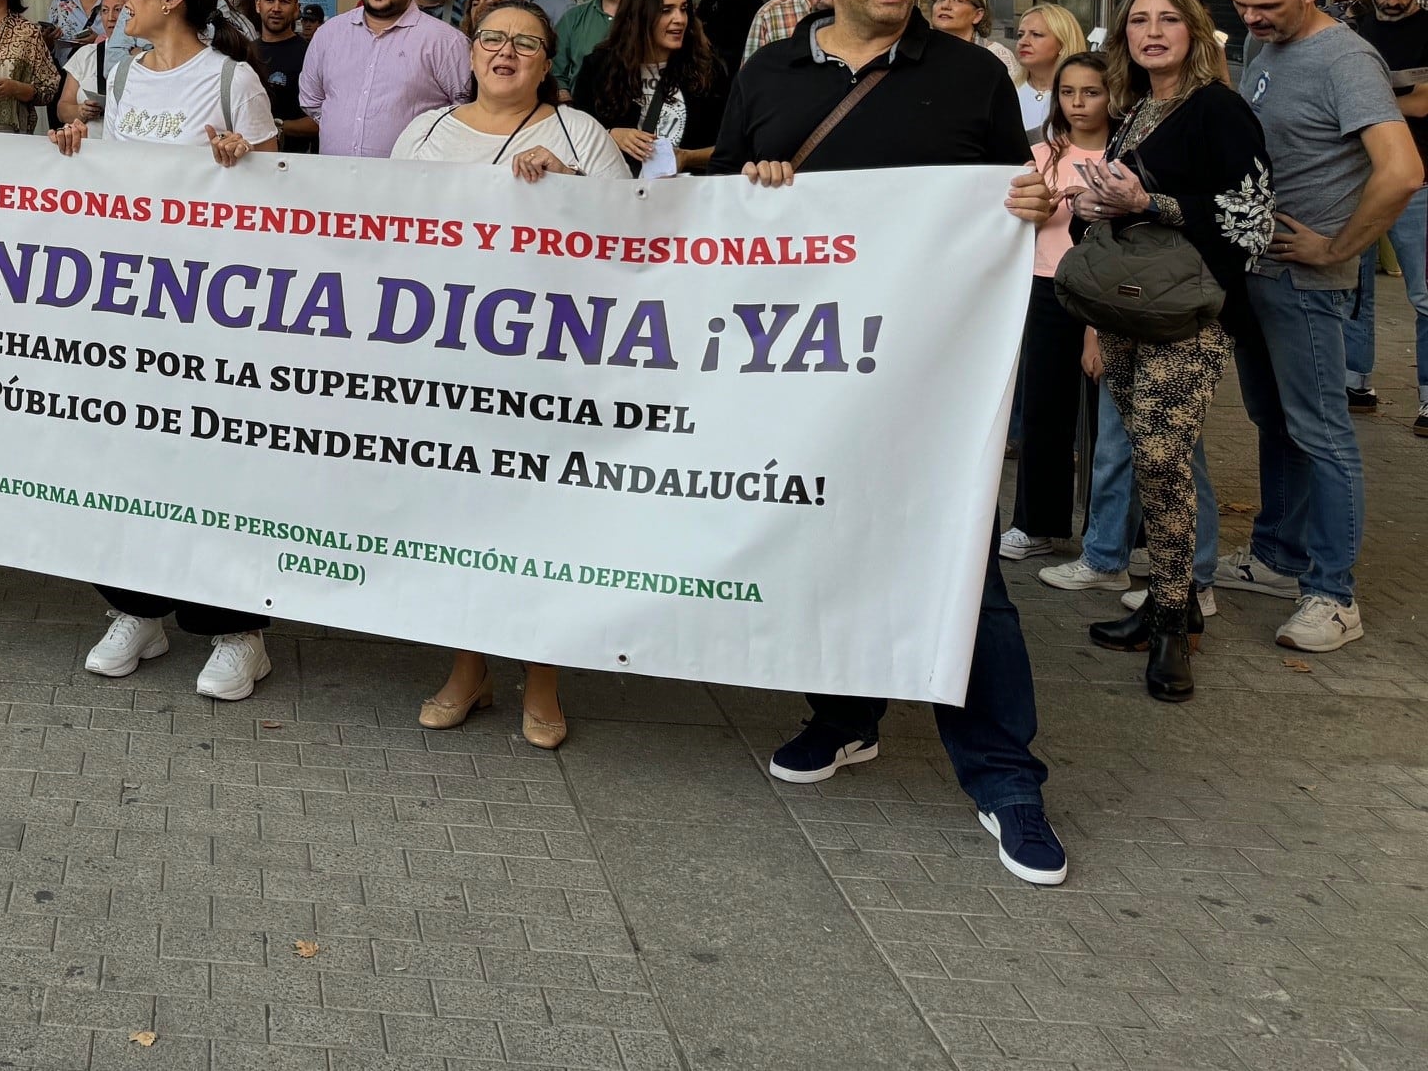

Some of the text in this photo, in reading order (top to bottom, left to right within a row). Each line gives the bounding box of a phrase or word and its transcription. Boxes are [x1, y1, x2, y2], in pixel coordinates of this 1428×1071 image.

[160, 198, 464, 248] DEPENDIENTES
[472, 223, 502, 251] Y
[510, 225, 858, 266] PROFESIONALES
[367, 276, 679, 371] DIGNA
[700, 301, 884, 374] ¡YA!
[135, 347, 207, 383] POR
[215, 358, 262, 389] LA
[270, 365, 603, 427] SUPERVIVENCIA
[612, 401, 696, 434] DEL
[135, 403, 182, 435] DE
[190, 405, 481, 474] DEPENDENCIA
[491, 449, 550, 482] EN
[82, 491, 198, 525] ANDALUZA
[201, 509, 230, 530] DE
[234, 514, 352, 551] PERSONAL
[356, 534, 388, 555] DE
[392, 539, 518, 575] ATENCIÓN
[521, 557, 539, 577] A
[542, 560, 574, 581] LA
[578, 565, 764, 603] DEPENDENCIA
[277, 551, 366, 586] (PAPAD)
